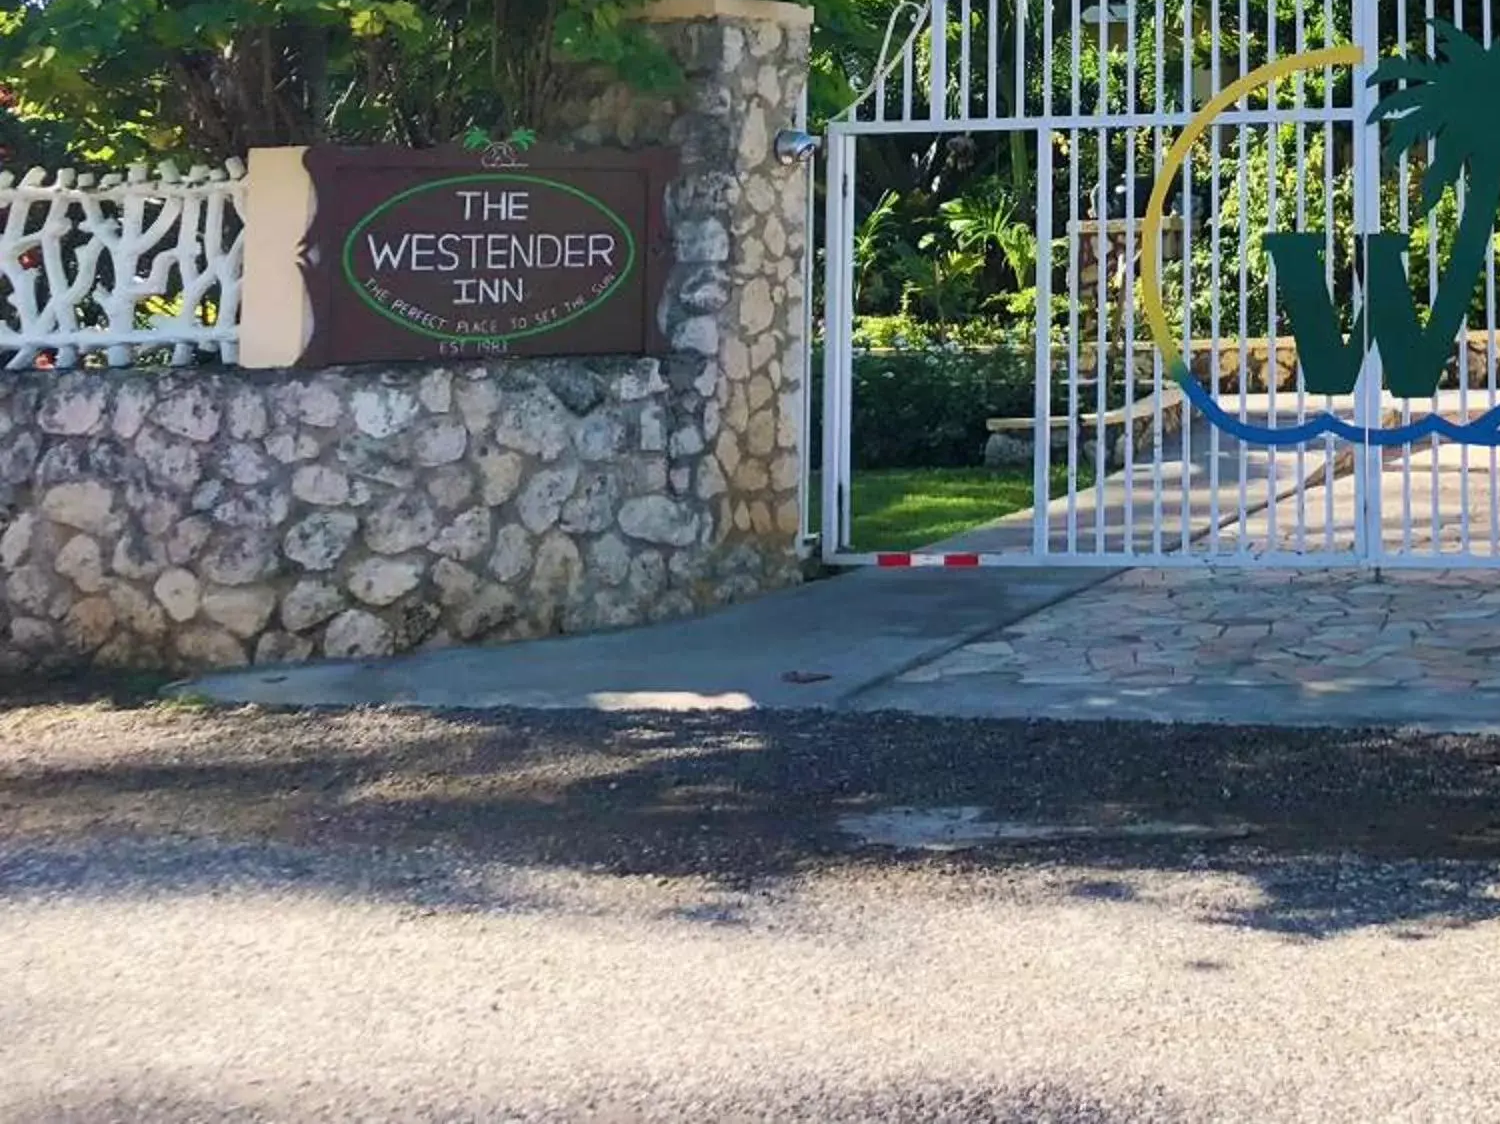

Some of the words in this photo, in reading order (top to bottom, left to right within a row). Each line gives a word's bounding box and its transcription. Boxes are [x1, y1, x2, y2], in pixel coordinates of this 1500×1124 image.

[456, 191, 529, 221] THE
[367, 233, 616, 272] WESTENDER
[364, 277, 391, 302] THE
[391, 298, 448, 330] PERFECT
[455, 319, 499, 334] PLACE
[511, 317, 528, 330] TO
[563, 294, 586, 313] THE
[590, 273, 616, 295] SUN
[452, 277, 524, 306] INN
